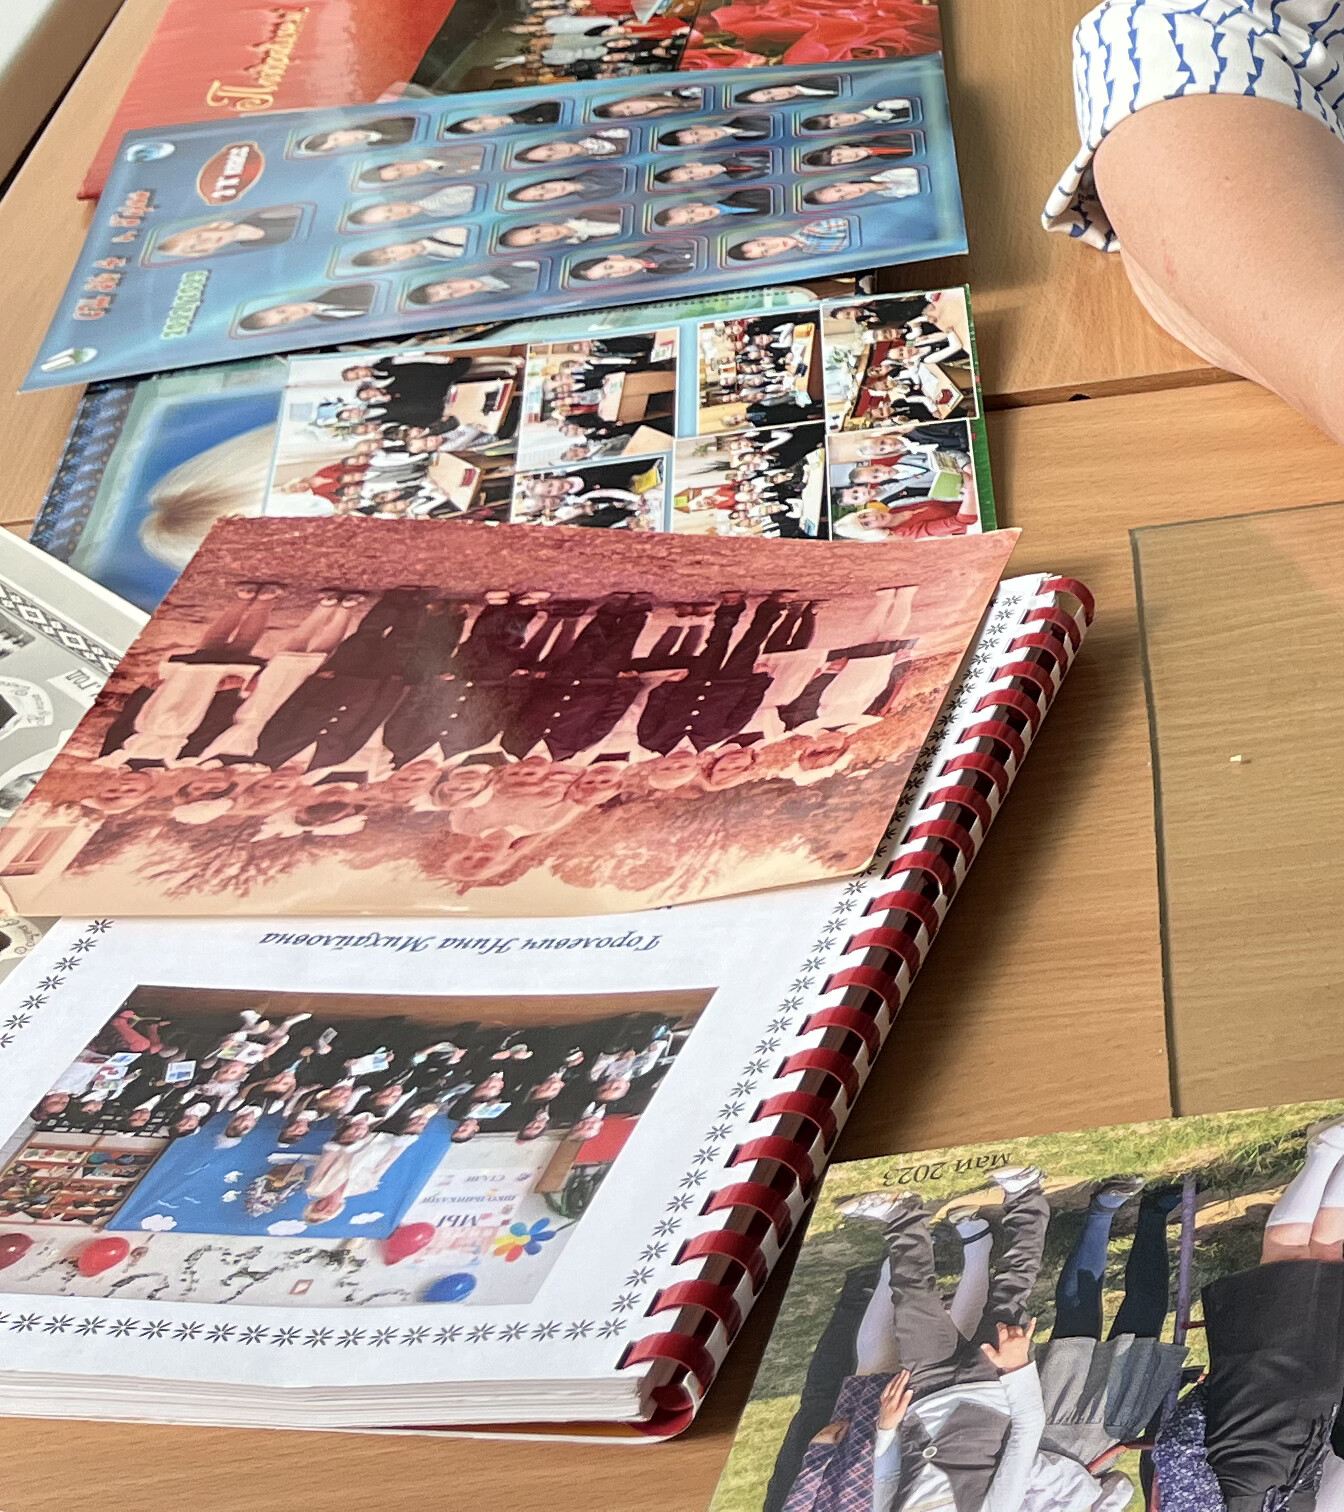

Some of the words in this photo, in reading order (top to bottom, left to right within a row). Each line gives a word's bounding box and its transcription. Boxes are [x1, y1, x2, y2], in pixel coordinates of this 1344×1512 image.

[257, 929, 434, 952] Михайловна
[436, 935, 519, 953] Нина
[520, 932, 661, 950] Горолевич
